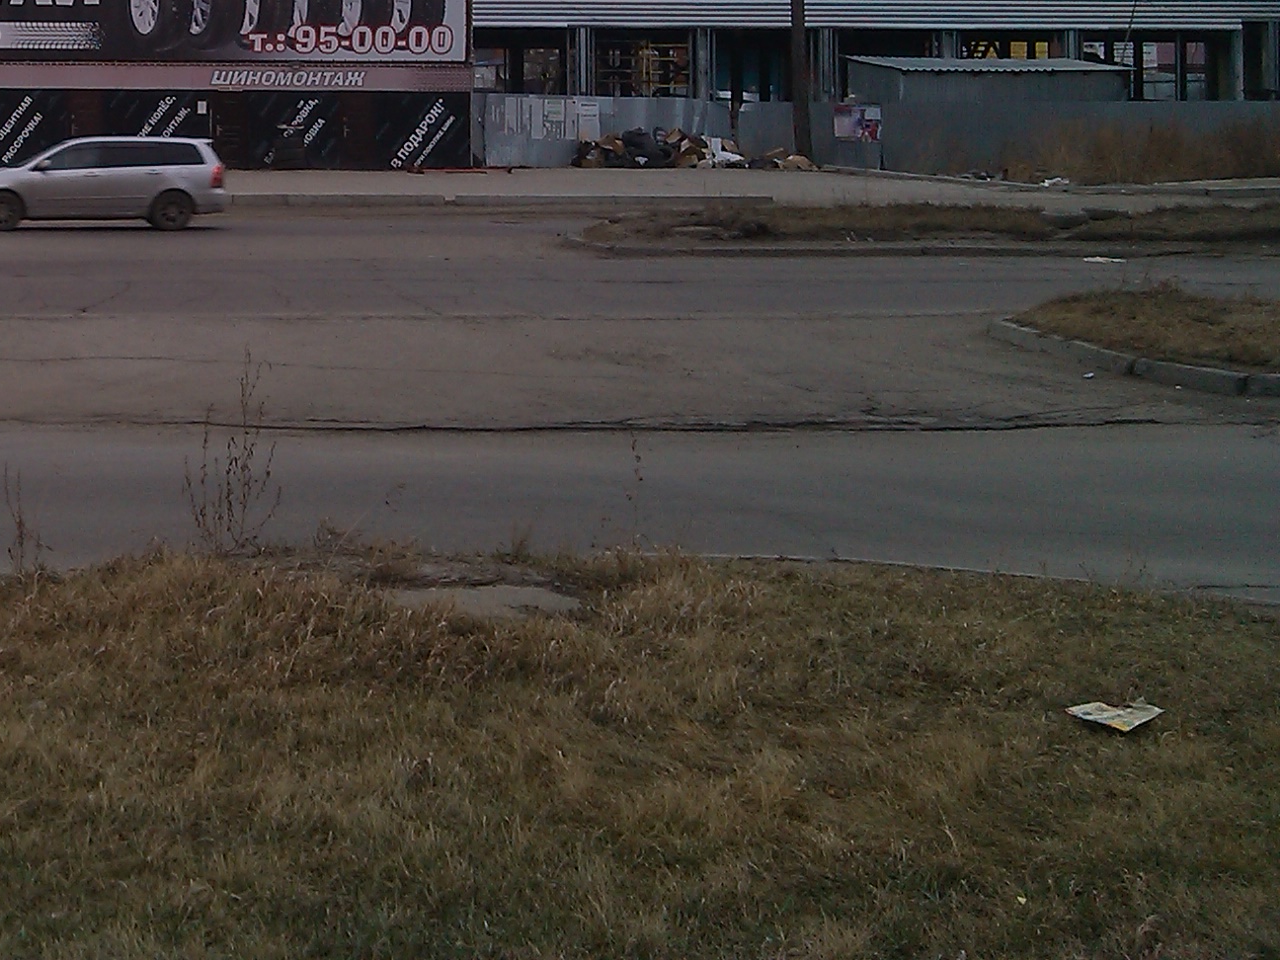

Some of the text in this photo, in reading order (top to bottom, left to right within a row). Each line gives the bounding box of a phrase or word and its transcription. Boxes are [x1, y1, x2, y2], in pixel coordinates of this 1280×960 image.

[294, 25, 454, 53] 95-00-00
[210, 70, 366, 87] ШИНОМОНТАЖ
[390, 158, 402, 168] В
